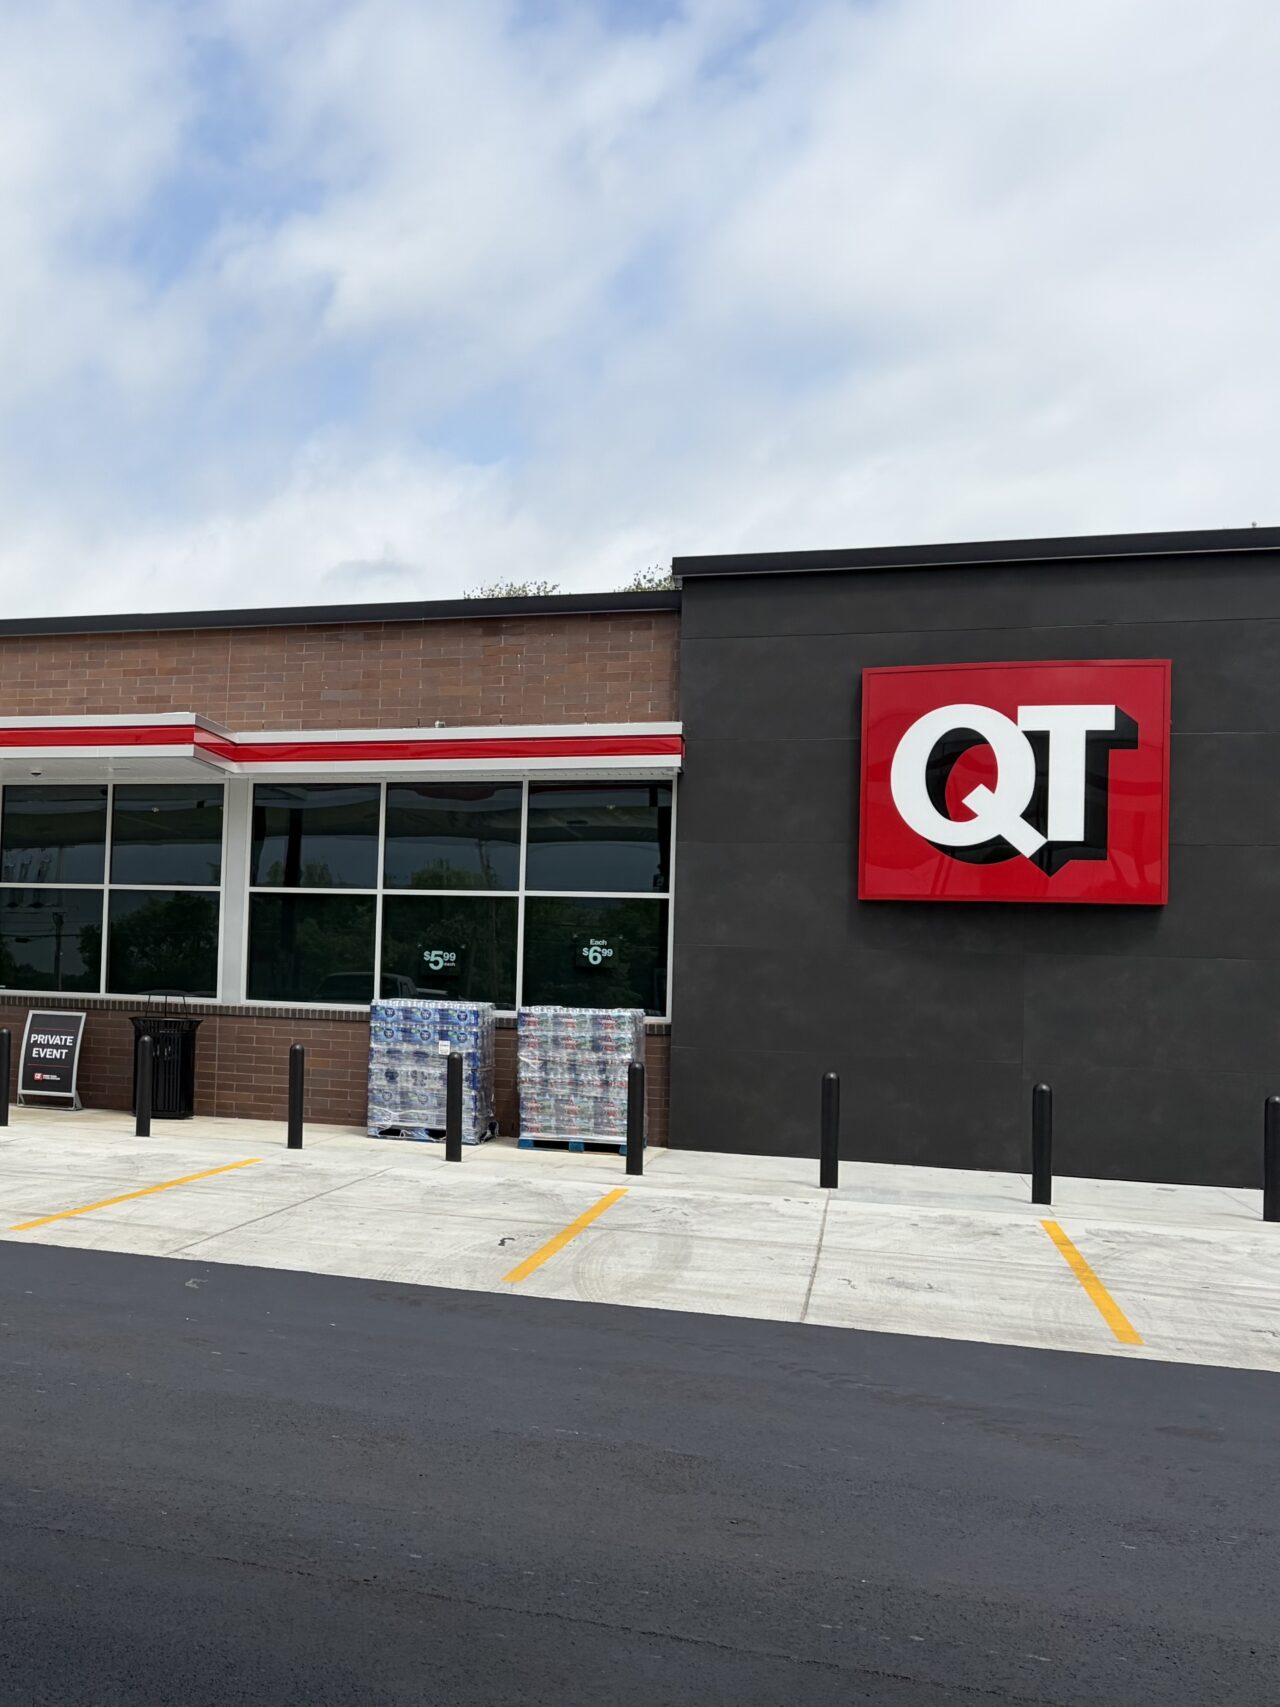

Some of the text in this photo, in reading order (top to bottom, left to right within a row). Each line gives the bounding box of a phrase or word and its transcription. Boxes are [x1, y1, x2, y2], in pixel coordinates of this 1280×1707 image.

[890, 703, 1117, 860] QT
[30, 1033, 74, 1045] PRIVATE
[32, 1047, 68, 1059] EVENT
